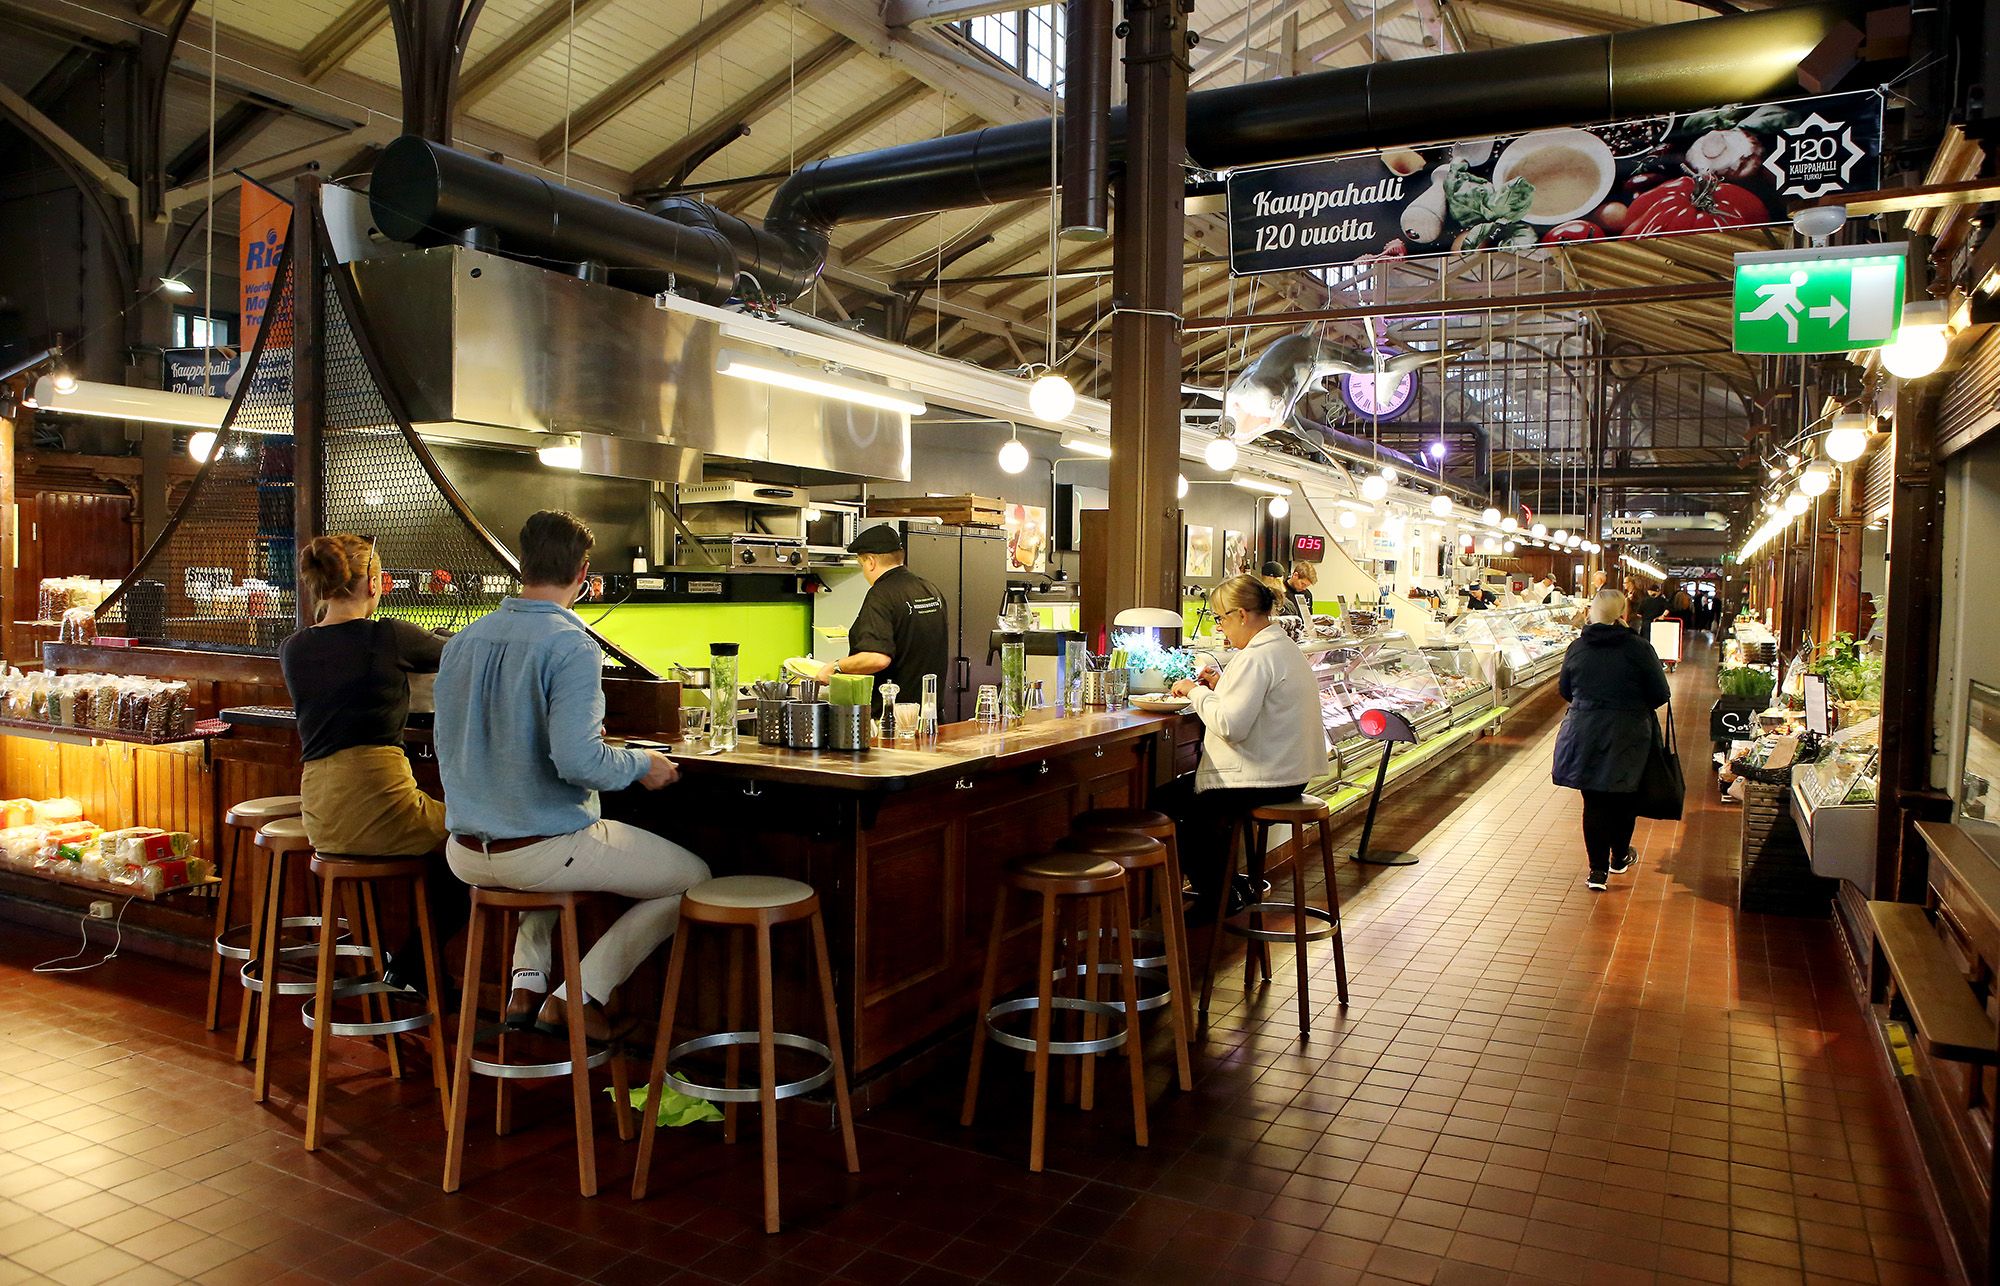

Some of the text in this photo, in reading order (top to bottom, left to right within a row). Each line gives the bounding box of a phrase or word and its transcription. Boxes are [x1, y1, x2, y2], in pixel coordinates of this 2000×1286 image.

[1789, 136, 1837, 163] 120
[1789, 160, 1837, 175] KAUPPAHALLI
[1803, 173, 1823, 181] TURKU
[1252, 176, 1405, 219] Kauppahalli
[1255, 218, 1376, 252] 120 vuotta
[1612, 526, 1642, 535] KALAA
[1297, 537, 1321, 550] 035
